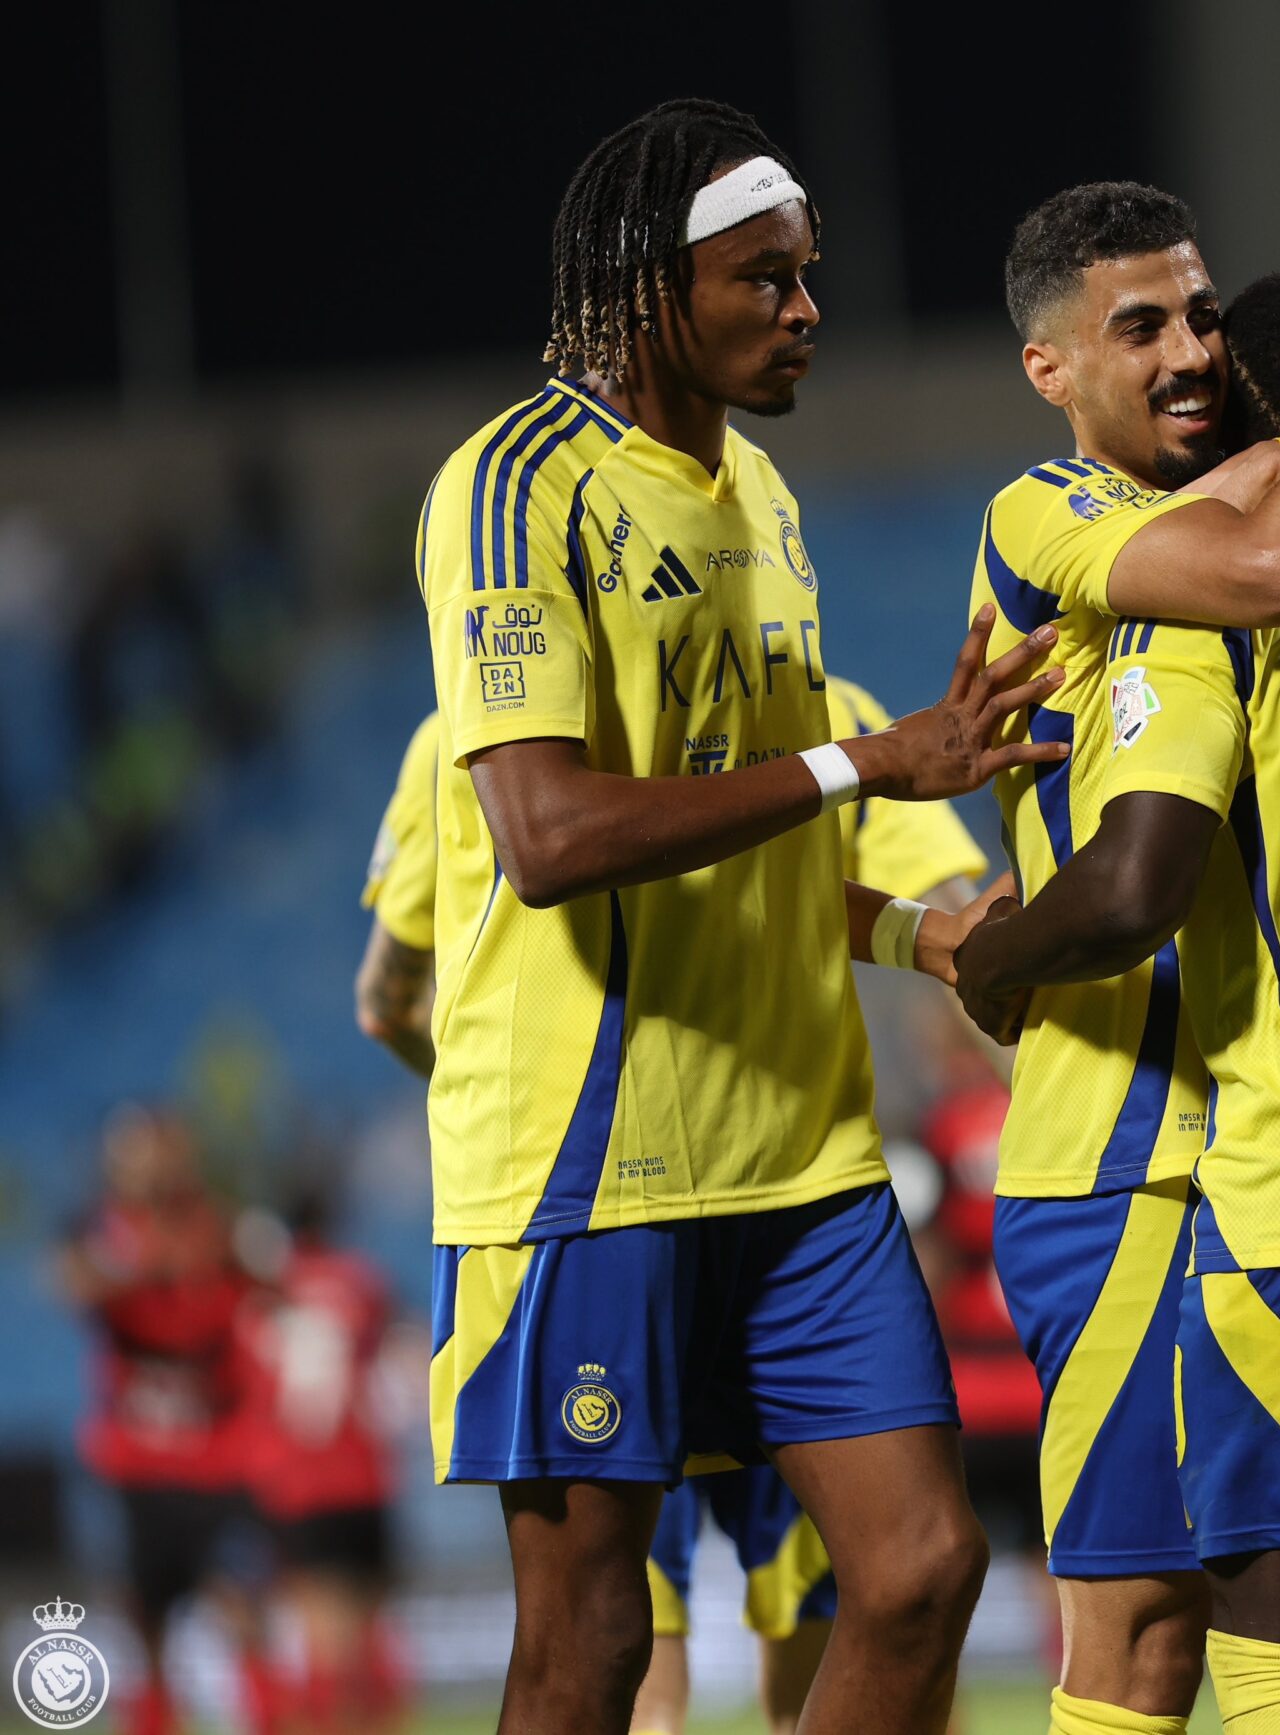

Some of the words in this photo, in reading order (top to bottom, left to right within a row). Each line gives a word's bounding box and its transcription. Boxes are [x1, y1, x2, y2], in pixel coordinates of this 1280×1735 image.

[493, 631, 546, 657] NOUG
[486, 702, 525, 713] DAZN.COM
[685, 734, 729, 751] NASSR
[618, 1160, 642, 1169] NASSR
[645, 1157, 664, 1166] RUNS
[628, 1169, 639, 1178] MY
[643, 1166, 666, 1177] BLOOD
[583, 1388, 612, 1405] NASSR
[569, 1420, 597, 1438] FOOTBALL
[599, 1422, 612, 1436] CLUB
